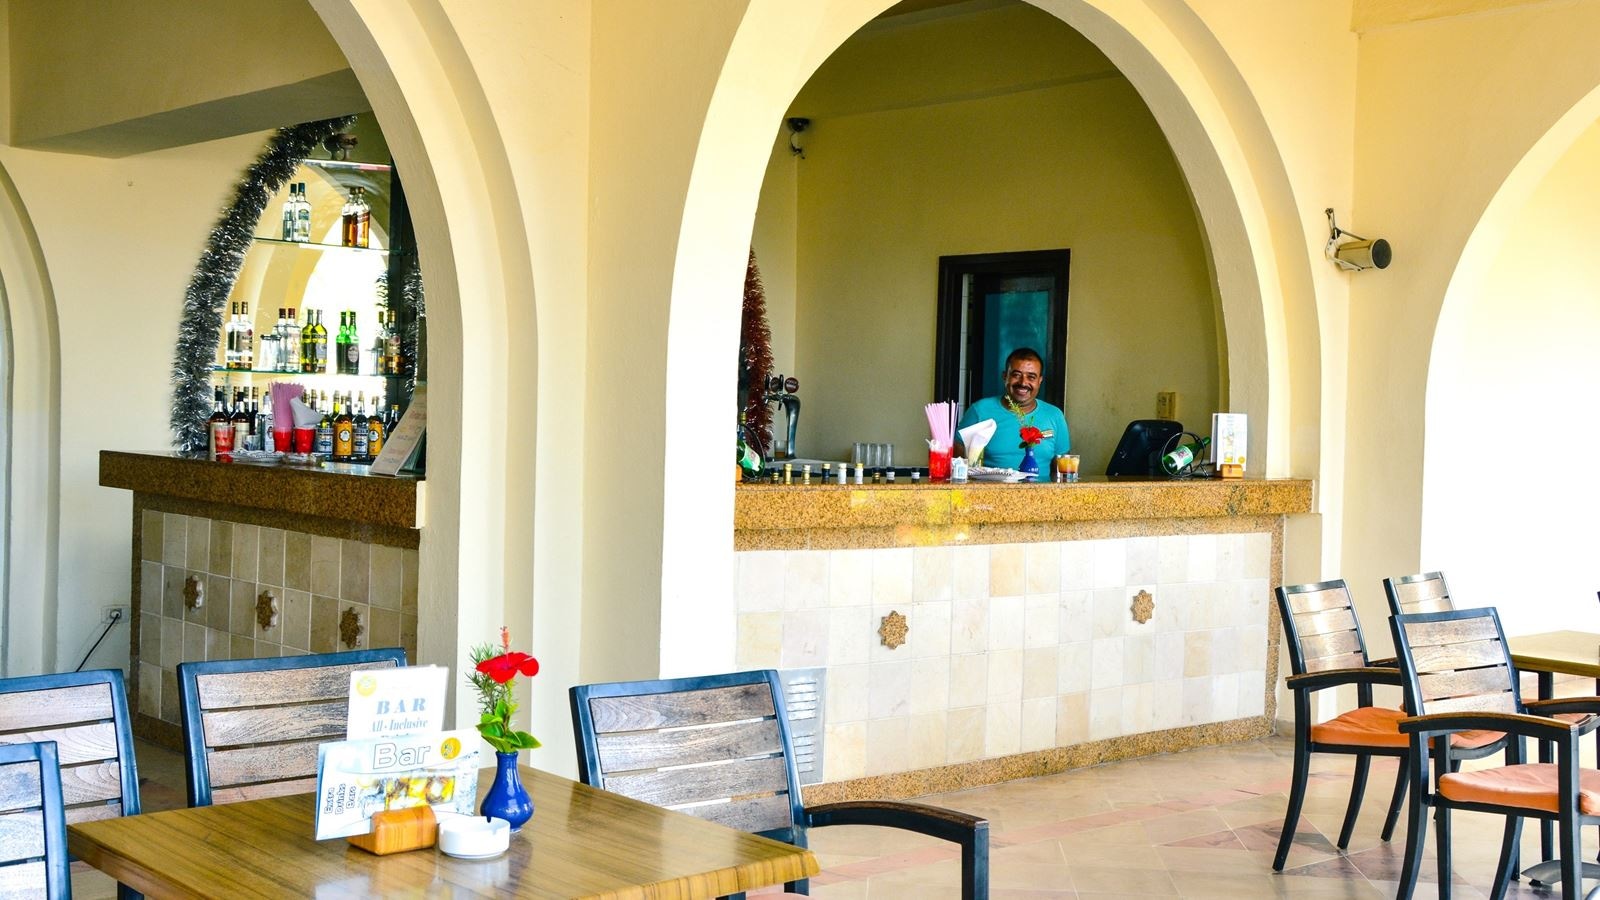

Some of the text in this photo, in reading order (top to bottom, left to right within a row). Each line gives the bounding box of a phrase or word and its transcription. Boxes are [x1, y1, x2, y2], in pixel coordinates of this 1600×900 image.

[376, 697, 426, 715] BAR
[369, 719, 383, 732] All
[389, 717, 428, 731] Inclusive
[373, 742, 431, 769] Bar
